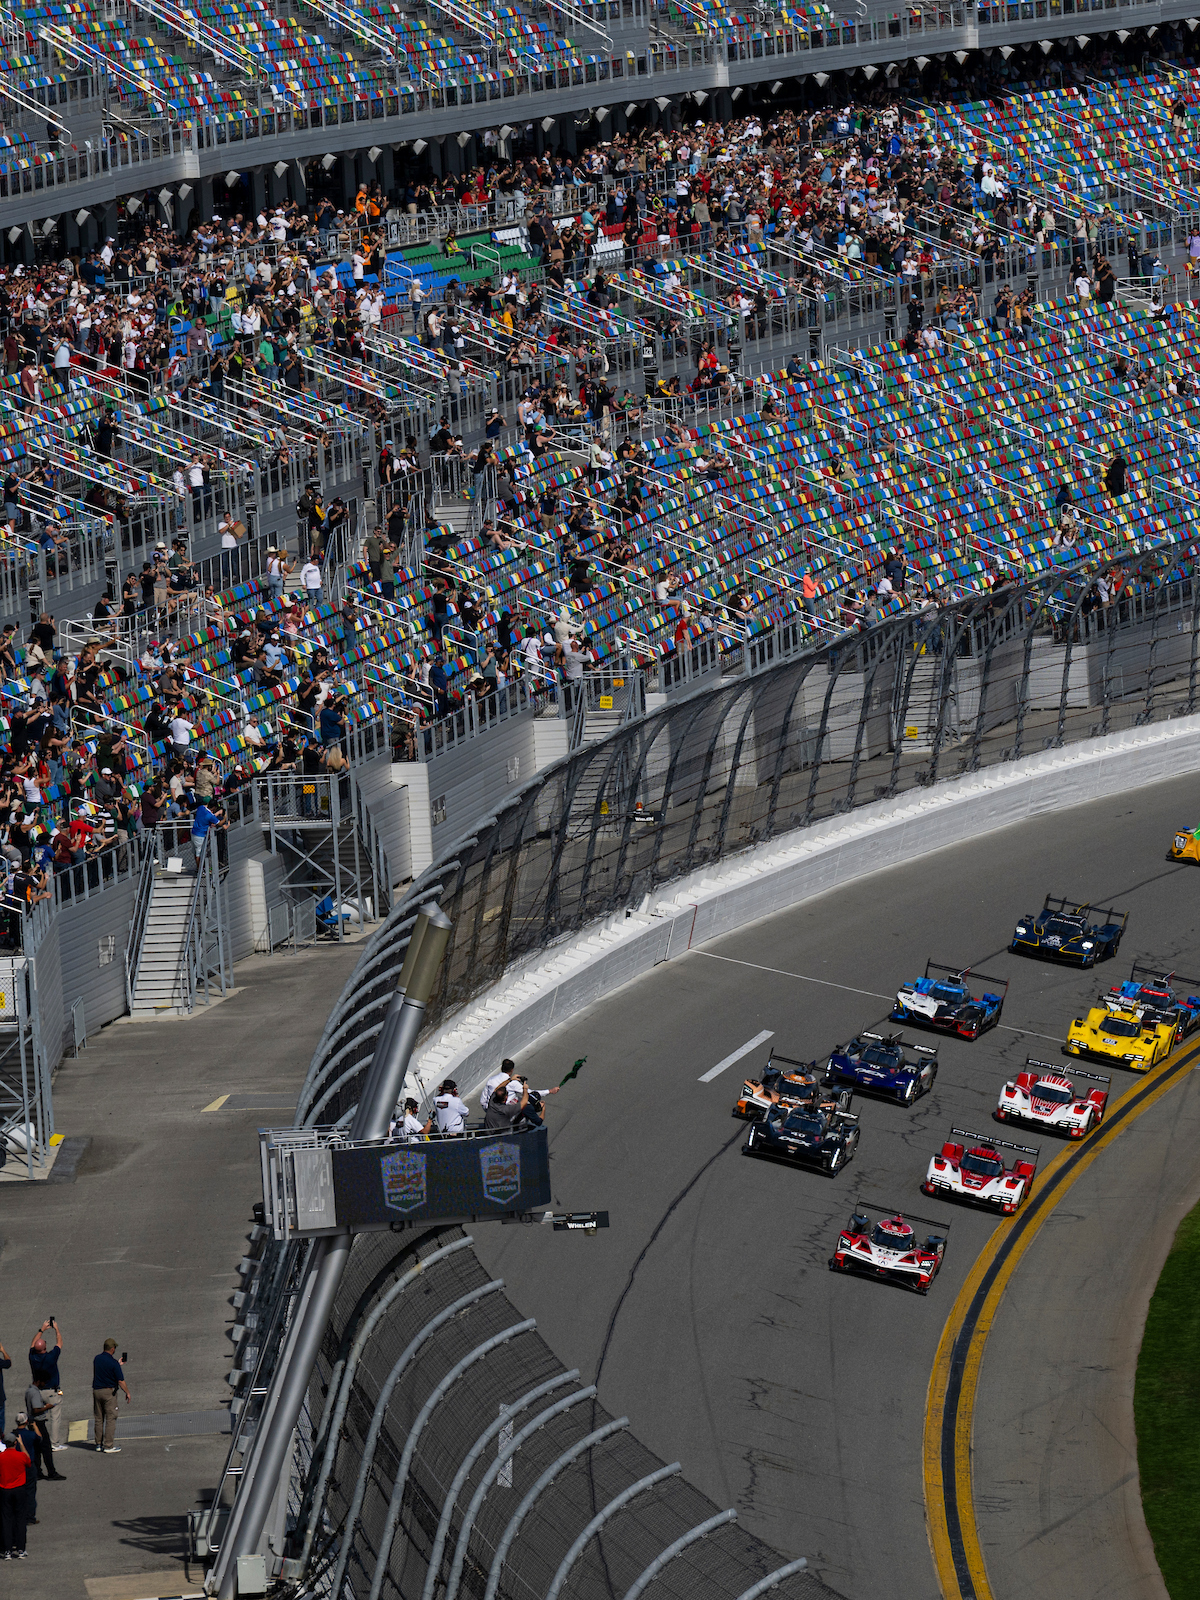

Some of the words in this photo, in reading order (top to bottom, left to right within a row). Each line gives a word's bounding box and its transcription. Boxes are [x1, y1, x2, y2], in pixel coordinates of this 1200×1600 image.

[913, 1045, 937, 1054] DEX
[855, 1068, 888, 1079] DEX
[835, 1111, 859, 1120] DEX
[778, 1136, 812, 1148] DEX
[952, 1128, 1039, 1155] PORSCHE
[488, 1154, 514, 1164] ROLEX
[486, 1163, 518, 1180] 24
[388, 1173, 422, 1189] 24
[488, 1184, 518, 1193] DAYTONA
[567, 1221, 597, 1229] WHELEN
